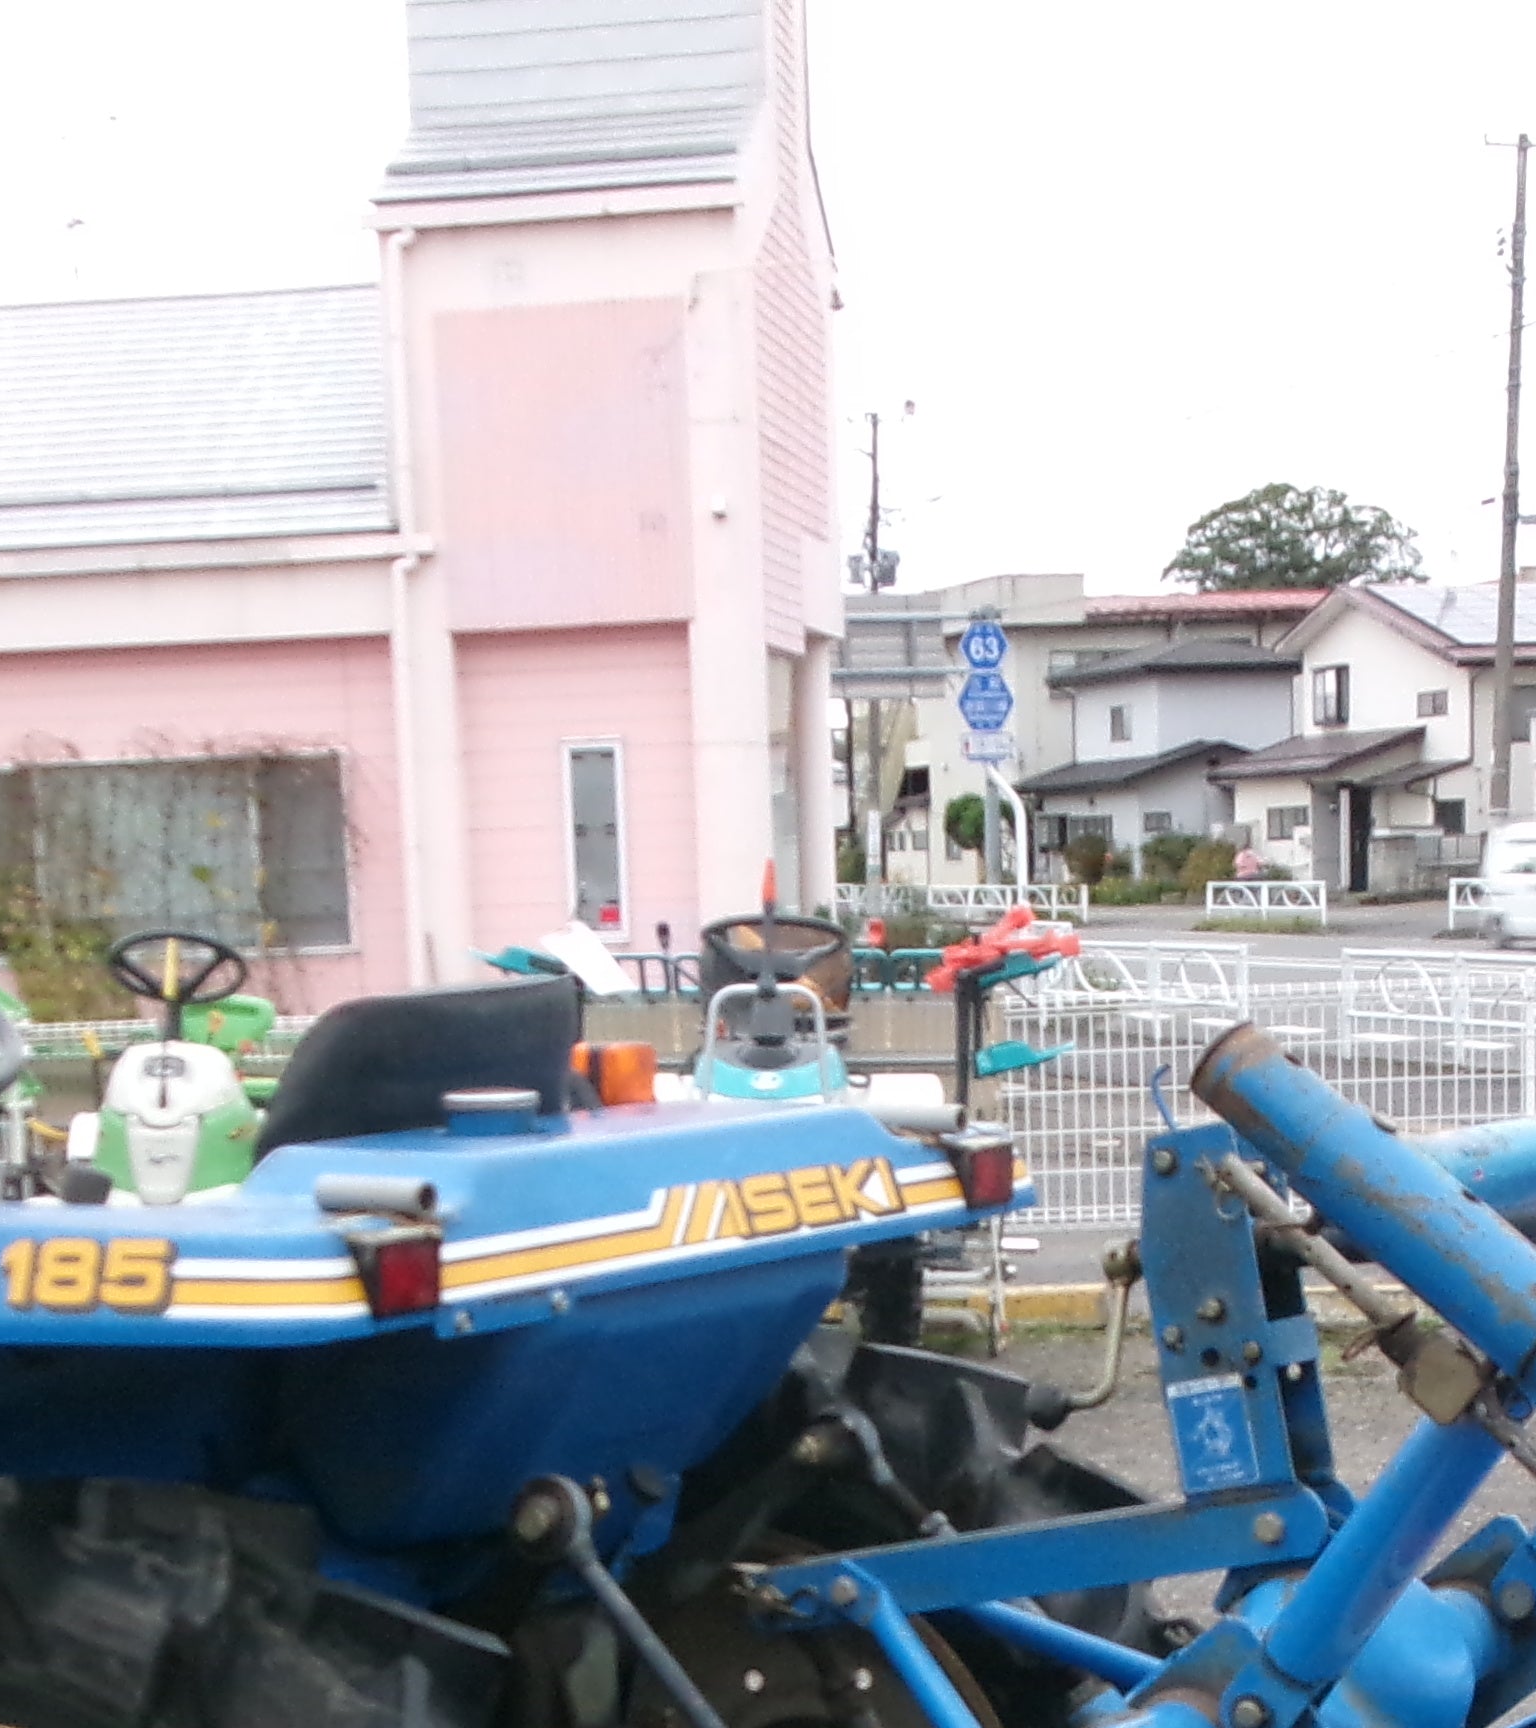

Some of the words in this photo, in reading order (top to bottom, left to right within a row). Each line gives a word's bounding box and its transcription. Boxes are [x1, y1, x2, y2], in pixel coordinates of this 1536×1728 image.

[969, 636, 999, 660] 63
[722, 1155, 905, 1239] ISEKI
[1, 1236, 178, 1315] 185
